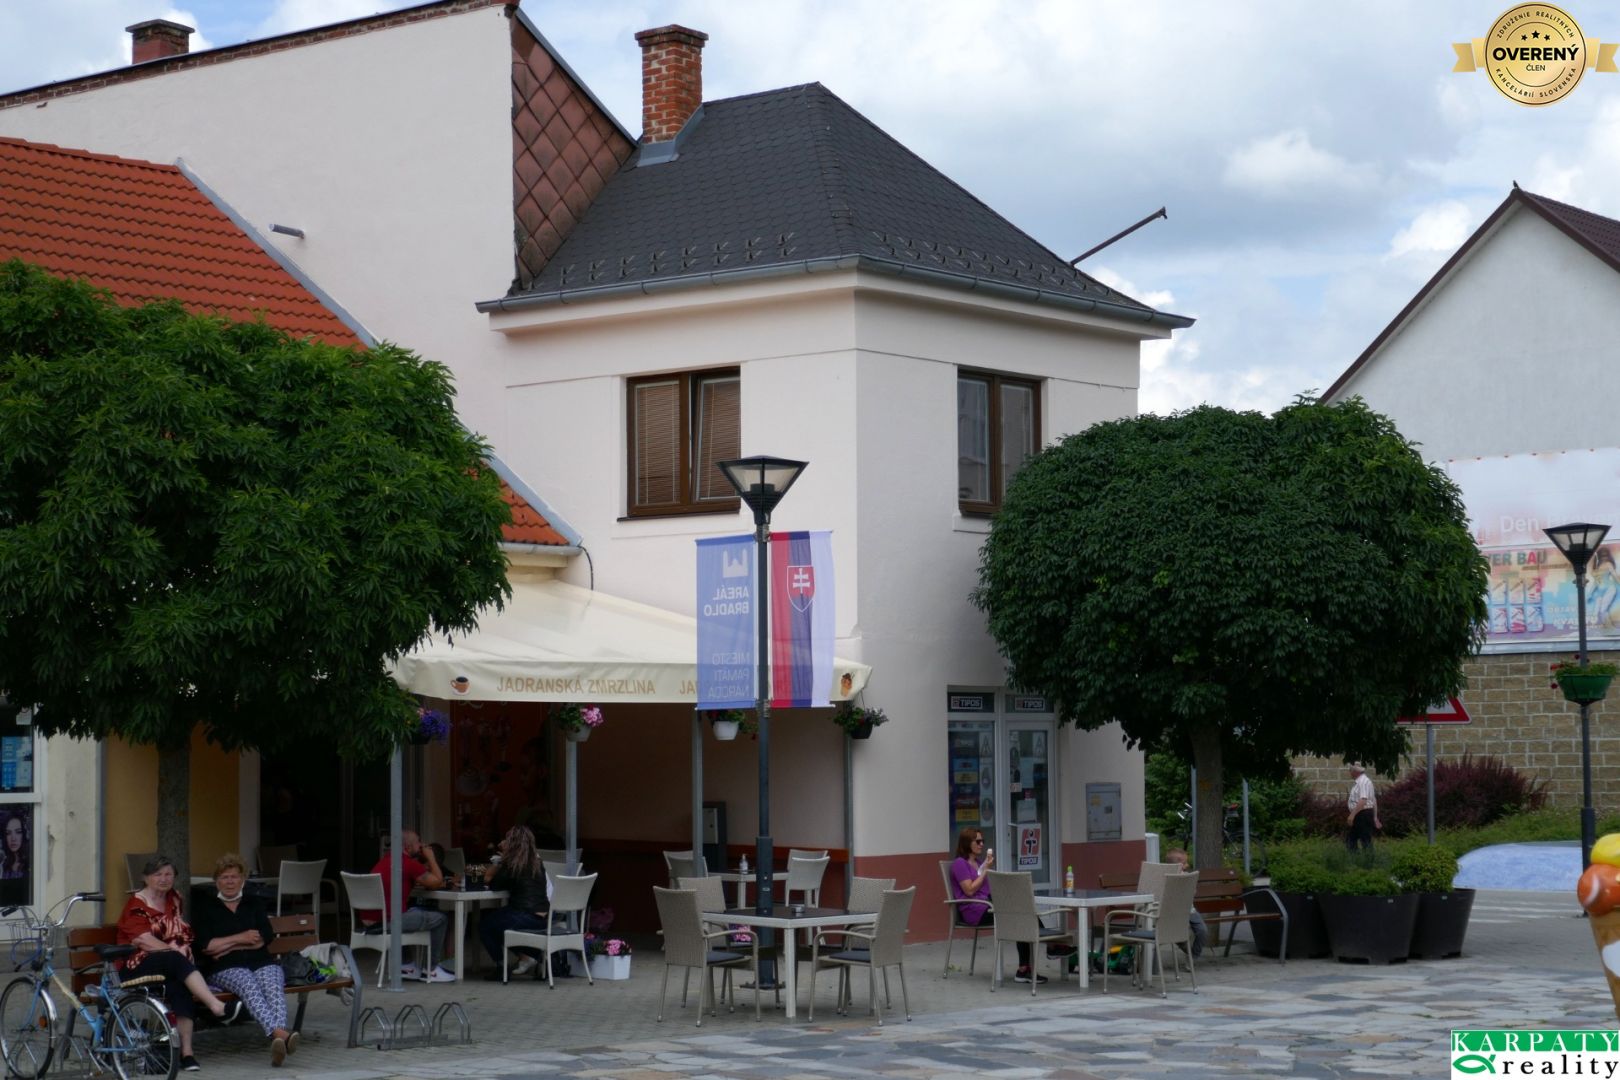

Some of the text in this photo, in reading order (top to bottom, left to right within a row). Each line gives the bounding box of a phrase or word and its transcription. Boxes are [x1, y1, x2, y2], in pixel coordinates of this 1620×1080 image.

[1500, 516, 1540, 533] Den
[496, 675, 584, 695] JADRANSKÁ
[587, 678, 656, 695] ZMRZLINA
[960, 699, 980, 708] TIPOS
[1023, 700, 1043, 708] TIPOS
